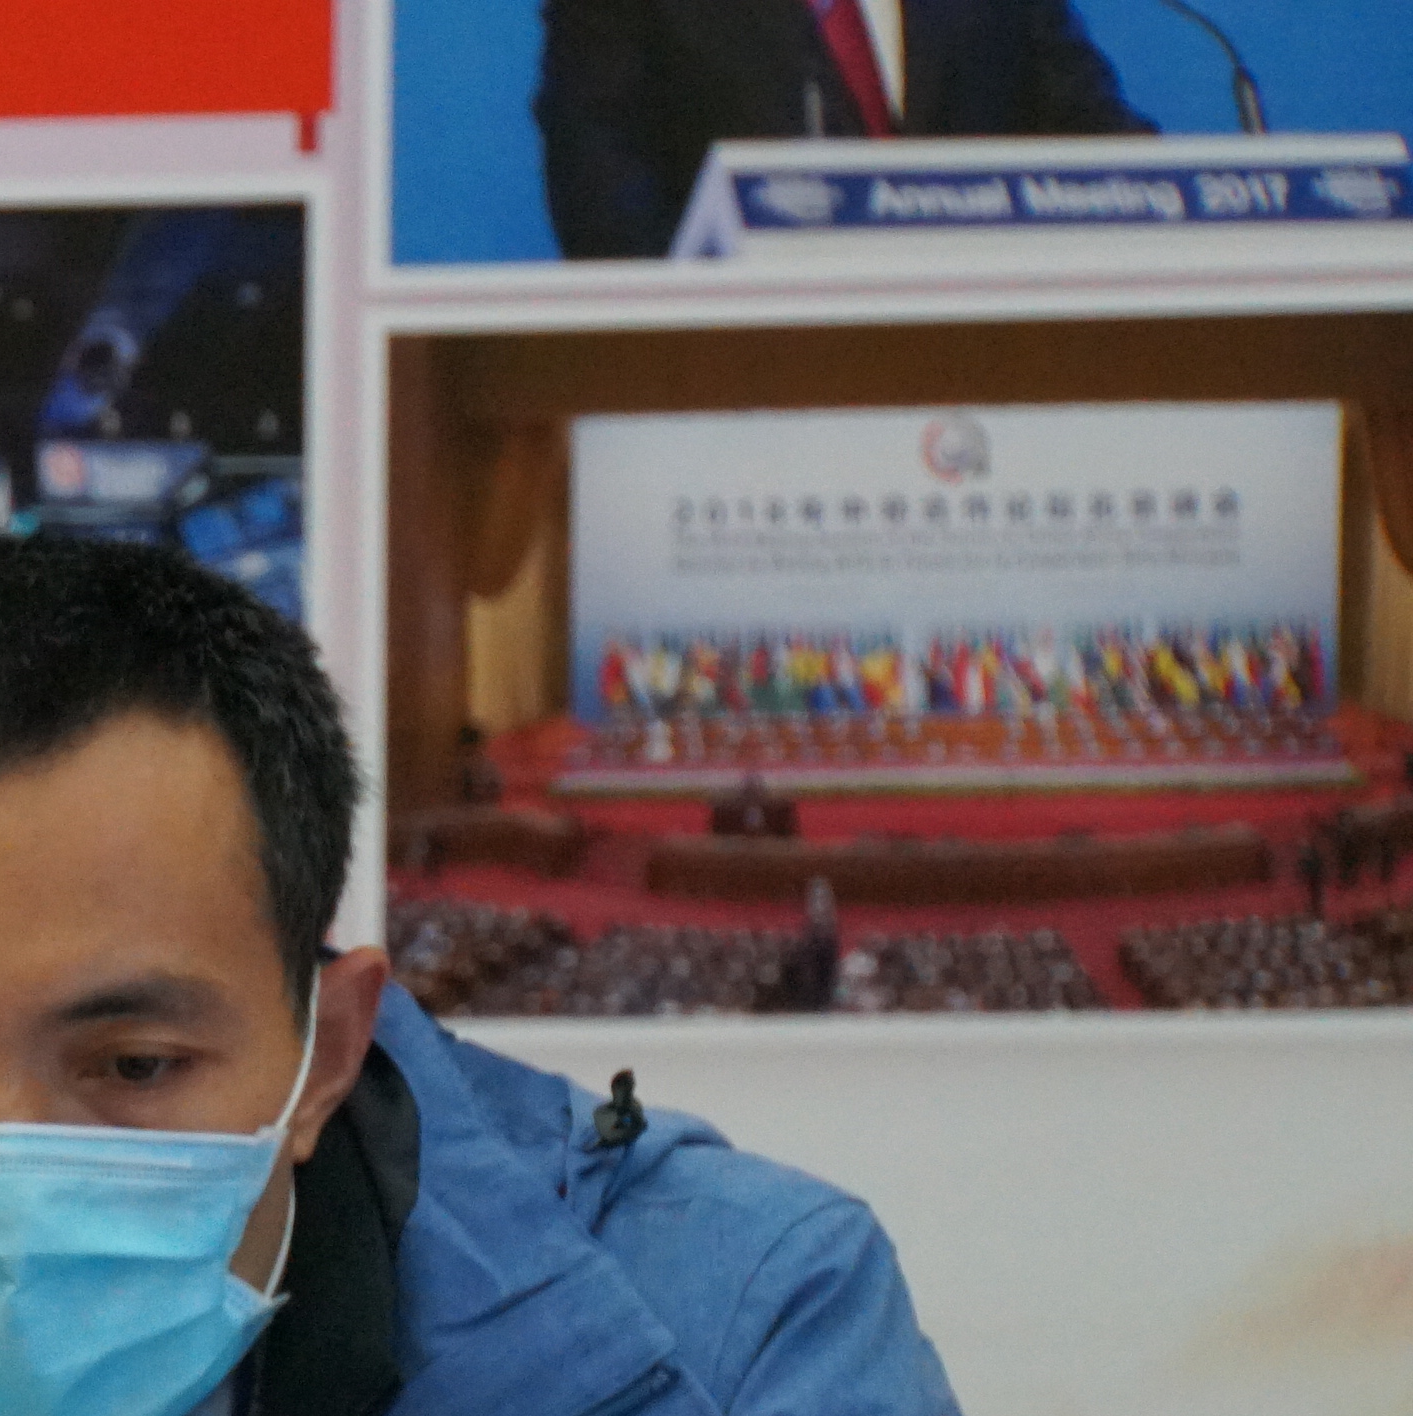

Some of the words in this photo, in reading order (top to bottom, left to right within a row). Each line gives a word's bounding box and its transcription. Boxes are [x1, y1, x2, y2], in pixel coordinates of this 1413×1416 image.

[873, 177, 1012, 219] Annual
[1020, 174, 1185, 222] Meeting
[1194, 172, 1290, 215] 2017
